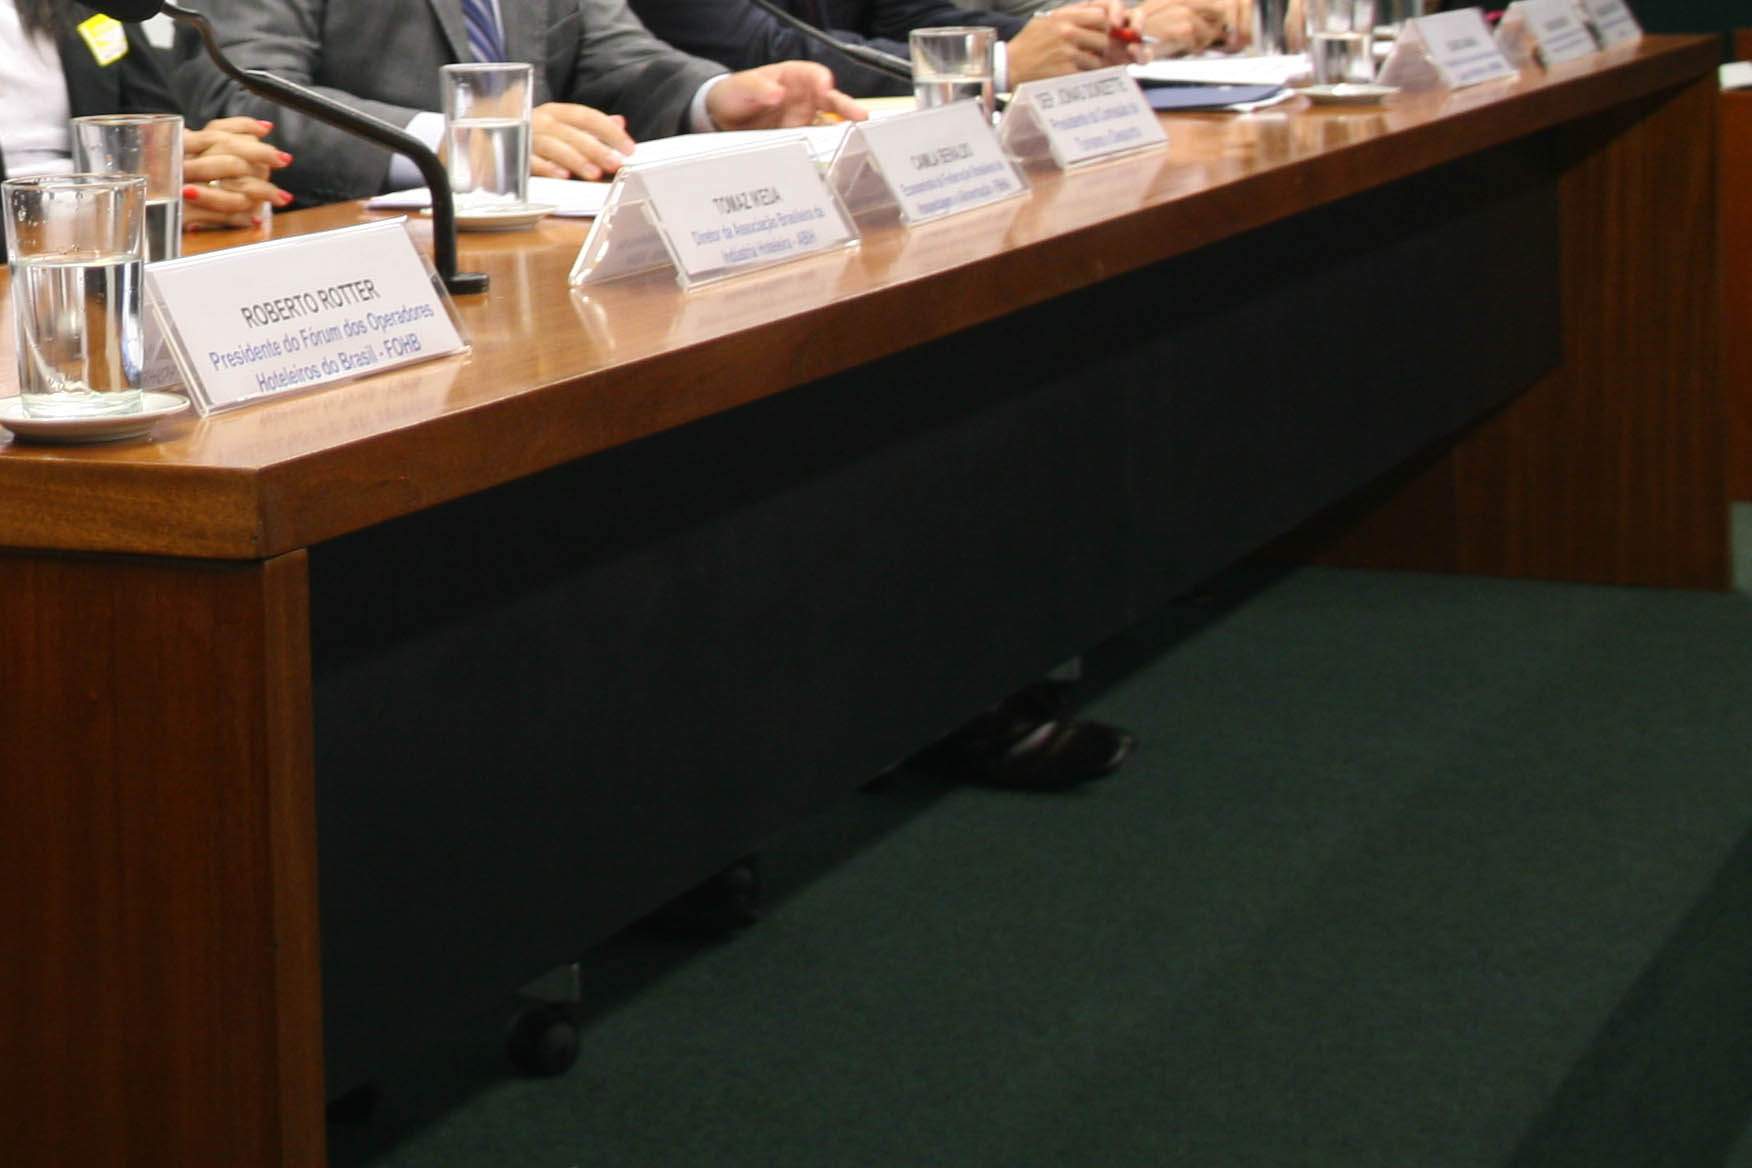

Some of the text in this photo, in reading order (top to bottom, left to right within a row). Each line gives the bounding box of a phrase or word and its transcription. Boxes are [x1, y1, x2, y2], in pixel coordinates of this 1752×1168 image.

[241, 278, 382, 329] ROBERTO ROTTER
[208, 303, 435, 372] Presidente do Fórum dos Operadores
[255, 363, 323, 393] Hoteleiros
[320, 356, 341, 376] do
[337, 344, 379, 372] Brasil
[382, 332, 423, 359] FOHB
